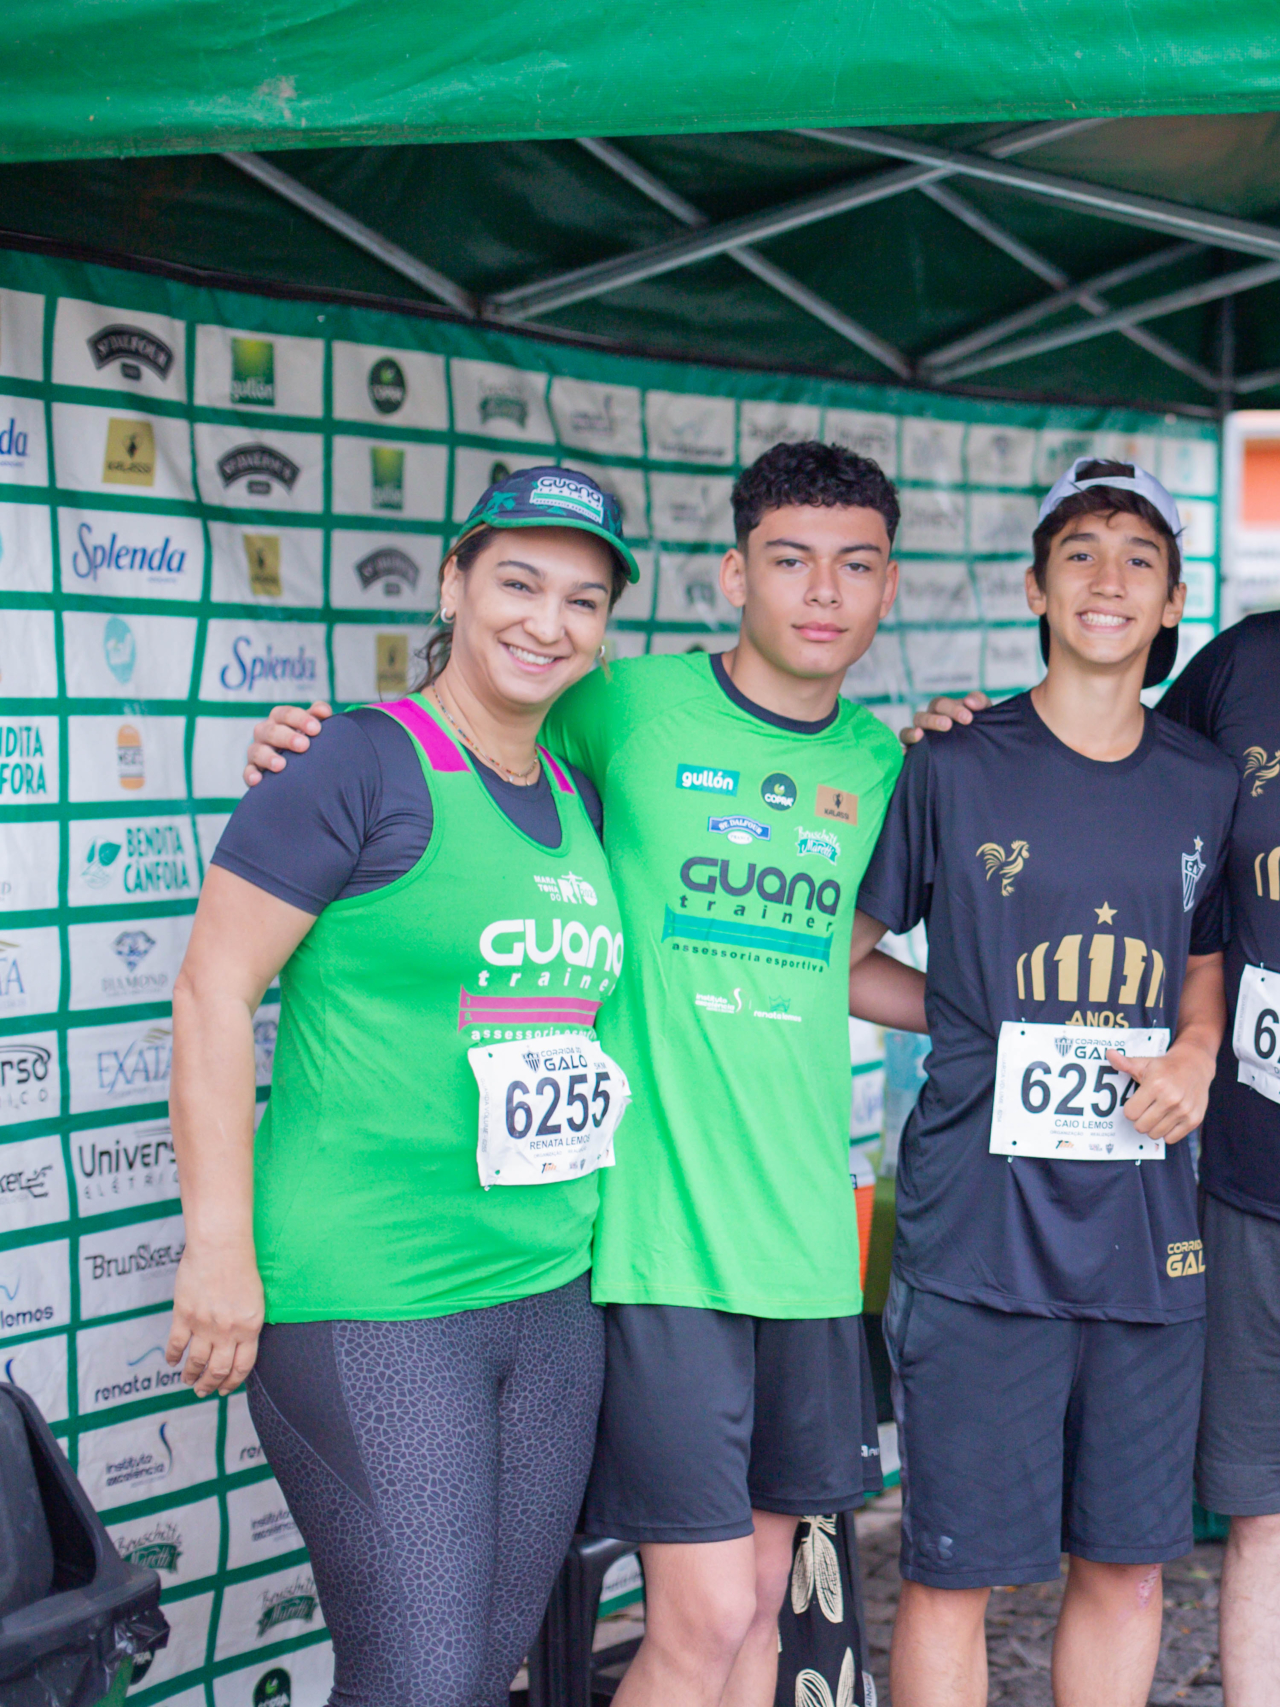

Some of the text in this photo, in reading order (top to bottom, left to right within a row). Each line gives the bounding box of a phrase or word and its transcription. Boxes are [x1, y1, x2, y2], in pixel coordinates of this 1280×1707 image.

[72, 523, 186, 582] Splenda
[219, 636, 317, 693] Splenda
[0, 763, 47, 796] FORA
[681, 770, 735, 791] gullón
[823, 807, 850, 821] KALASSI
[126, 827, 185, 858] BENDITA
[678, 893, 833, 933] trainer
[671, 942, 824, 974] assessoria esportiva
[1065, 1010, 1130, 1029] ANOS
[1074, 1038, 1113, 1047] CORRIDA
[543, 1054, 588, 1072] GALO
[505, 1071, 611, 1140] 6255
[1054, 1118, 1115, 1130] CAIO LEMOS
[529, 1138, 564, 1151] RENATA
[565, 1133, 591, 1147] LEMOS
[78, 1138, 178, 1178] Univers
[1166, 1250, 1207, 1279] GAL
[0, 1305, 54, 1330] lemos
[94, 1374, 152, 1404] renata
